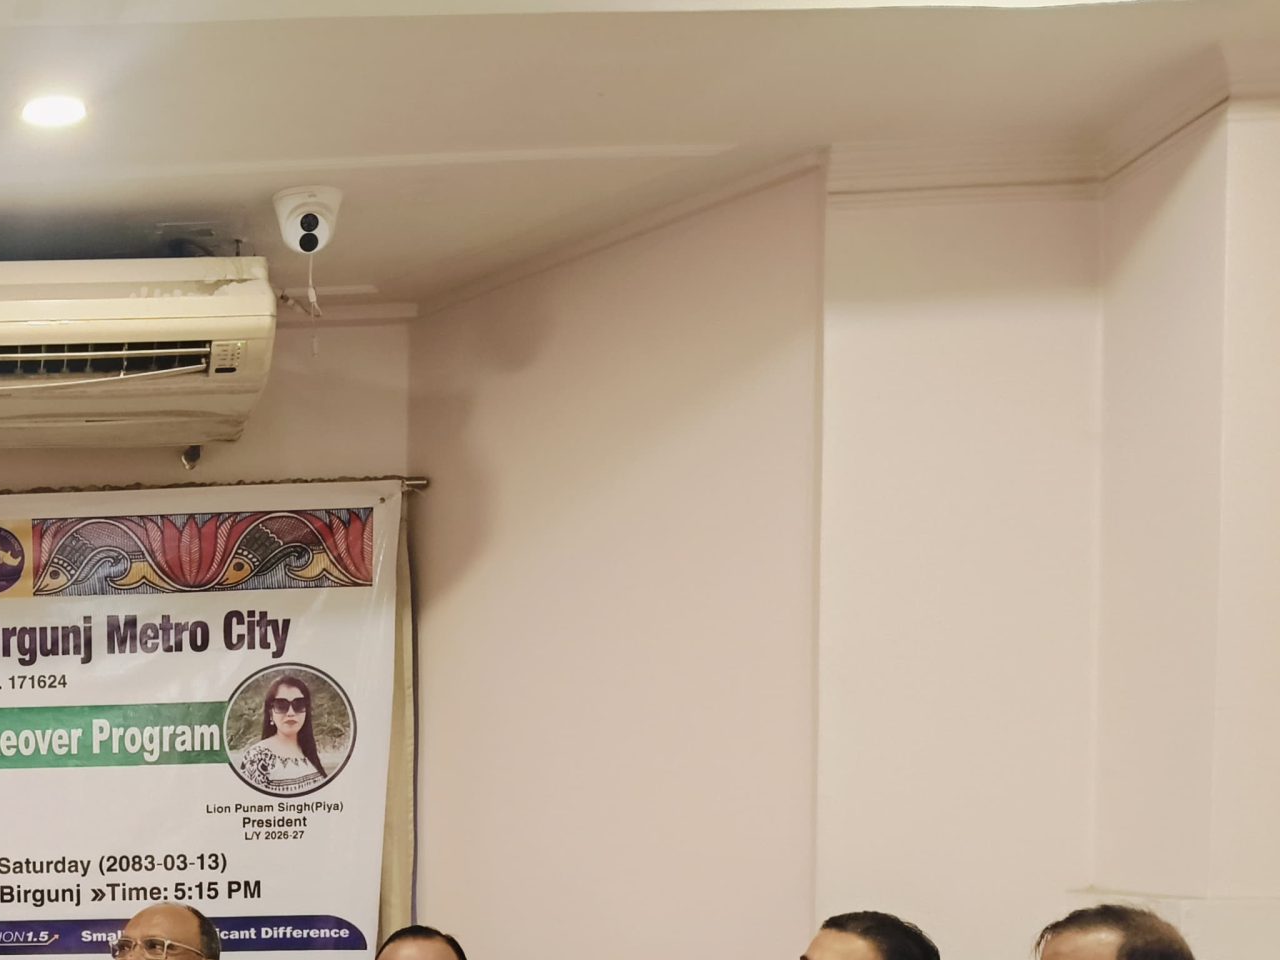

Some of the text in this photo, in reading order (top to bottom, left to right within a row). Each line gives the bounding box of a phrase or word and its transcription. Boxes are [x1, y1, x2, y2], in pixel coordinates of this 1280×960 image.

[106, 614, 210, 654] Metro
[223, 610, 290, 658] City
[8, 674, 67, 689] 171624
[92, 719, 220, 762] Program
[206, 801, 344, 814] Lion Punam Singh(Piya)
[242, 816, 307, 828] President
[244, 830, 304, 840] L/Y 2026-27
[98, 852, 227, 876] (2083-03-13)
[0, 884, 80, 907] Birgunj
[106, 884, 168, 900] Time:
[173, 882, 218, 900] 5:15
[227, 880, 262, 898] PM
[261, 927, 350, 938] Difference
